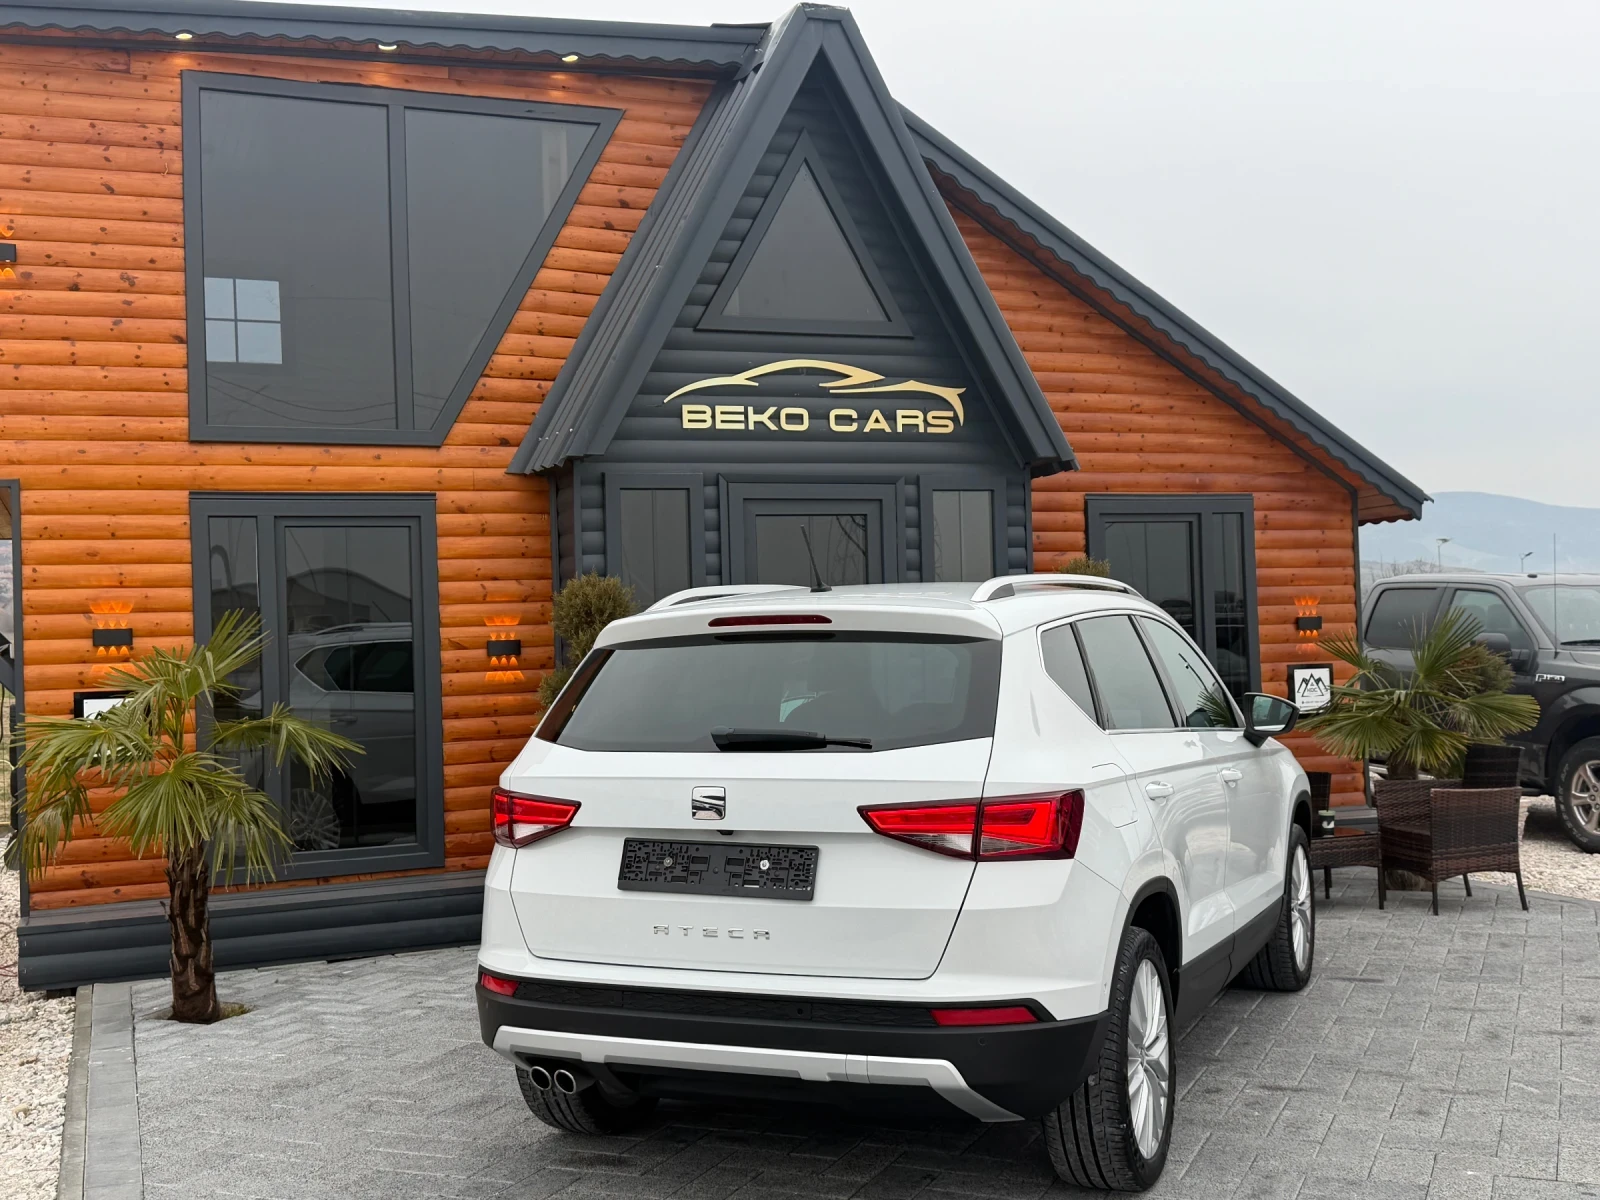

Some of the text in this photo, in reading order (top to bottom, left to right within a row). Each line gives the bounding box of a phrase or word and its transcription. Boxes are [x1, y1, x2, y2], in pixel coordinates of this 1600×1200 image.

[682, 404, 954, 433] BEKO CARS
[653, 924, 770, 940] ATECA
